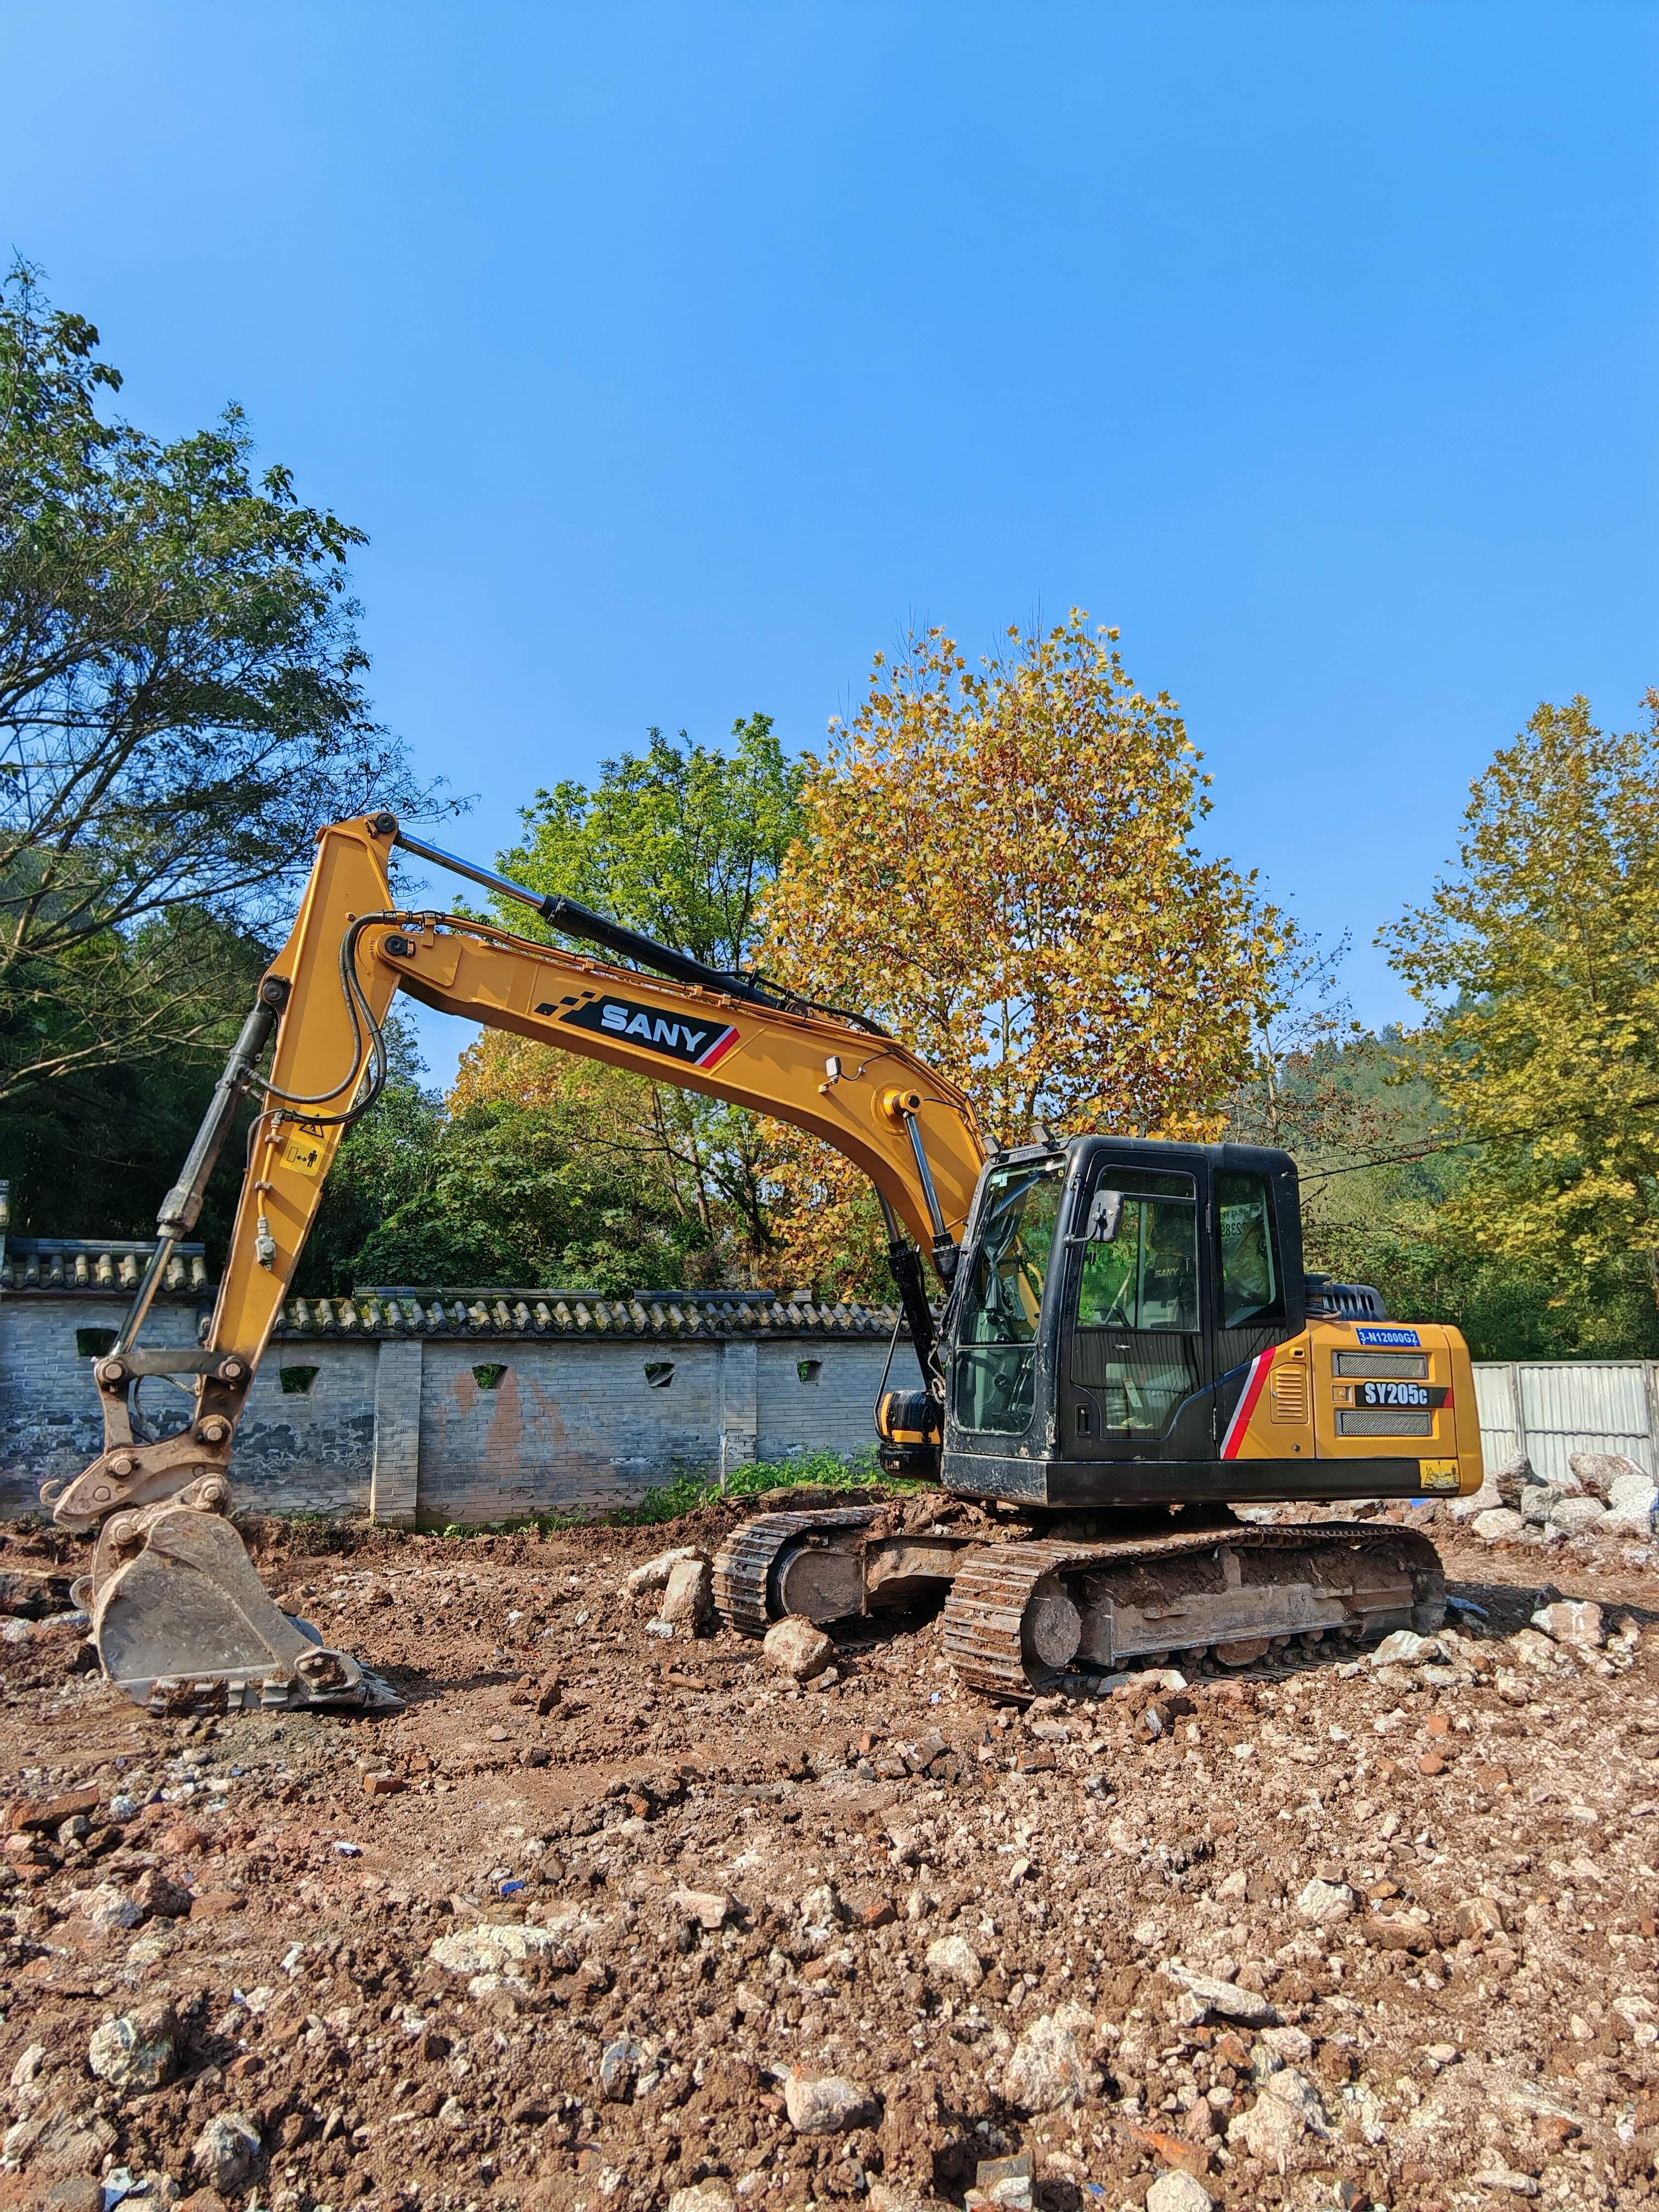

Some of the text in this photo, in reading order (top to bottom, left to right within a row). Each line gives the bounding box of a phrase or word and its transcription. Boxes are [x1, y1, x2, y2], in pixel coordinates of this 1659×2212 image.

[601, 1005, 707, 1052] SANY
[1154, 1267, 1179, 1278] SANY
[1359, 1331, 1418, 1343] 3-N12000G2
[1364, 1383, 1427, 1404] SY205c
